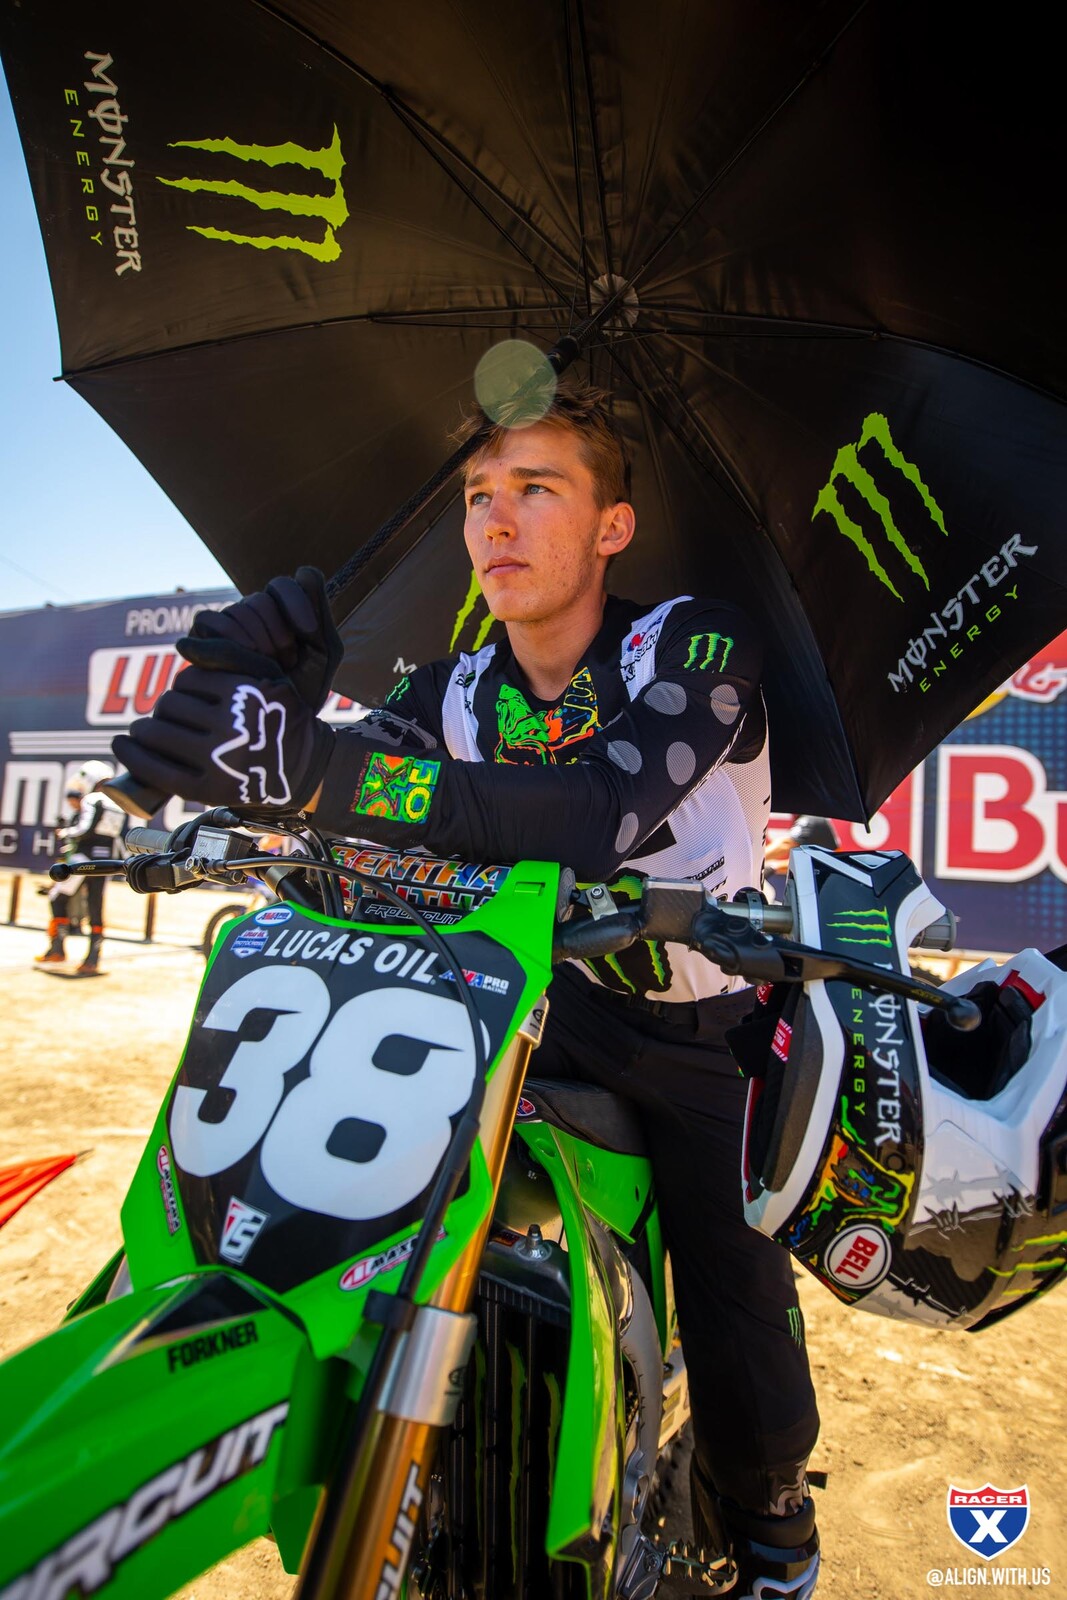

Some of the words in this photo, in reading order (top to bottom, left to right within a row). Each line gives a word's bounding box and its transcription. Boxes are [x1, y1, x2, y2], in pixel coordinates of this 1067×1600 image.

[64, 88, 103, 246] ENERGY
[919, 584, 1018, 692] ENERGY
[264, 929, 374, 965] LUCAS
[373, 942, 439, 984] OIL
[484, 974, 510, 990] PRO
[482, 984, 507, 995] RACING
[851, 987, 866, 1116] ENERGY
[169, 964, 491, 1221] 38
[834, 1235, 880, 1280] BELL
[167, 1319, 259, 1374] FORKNER
